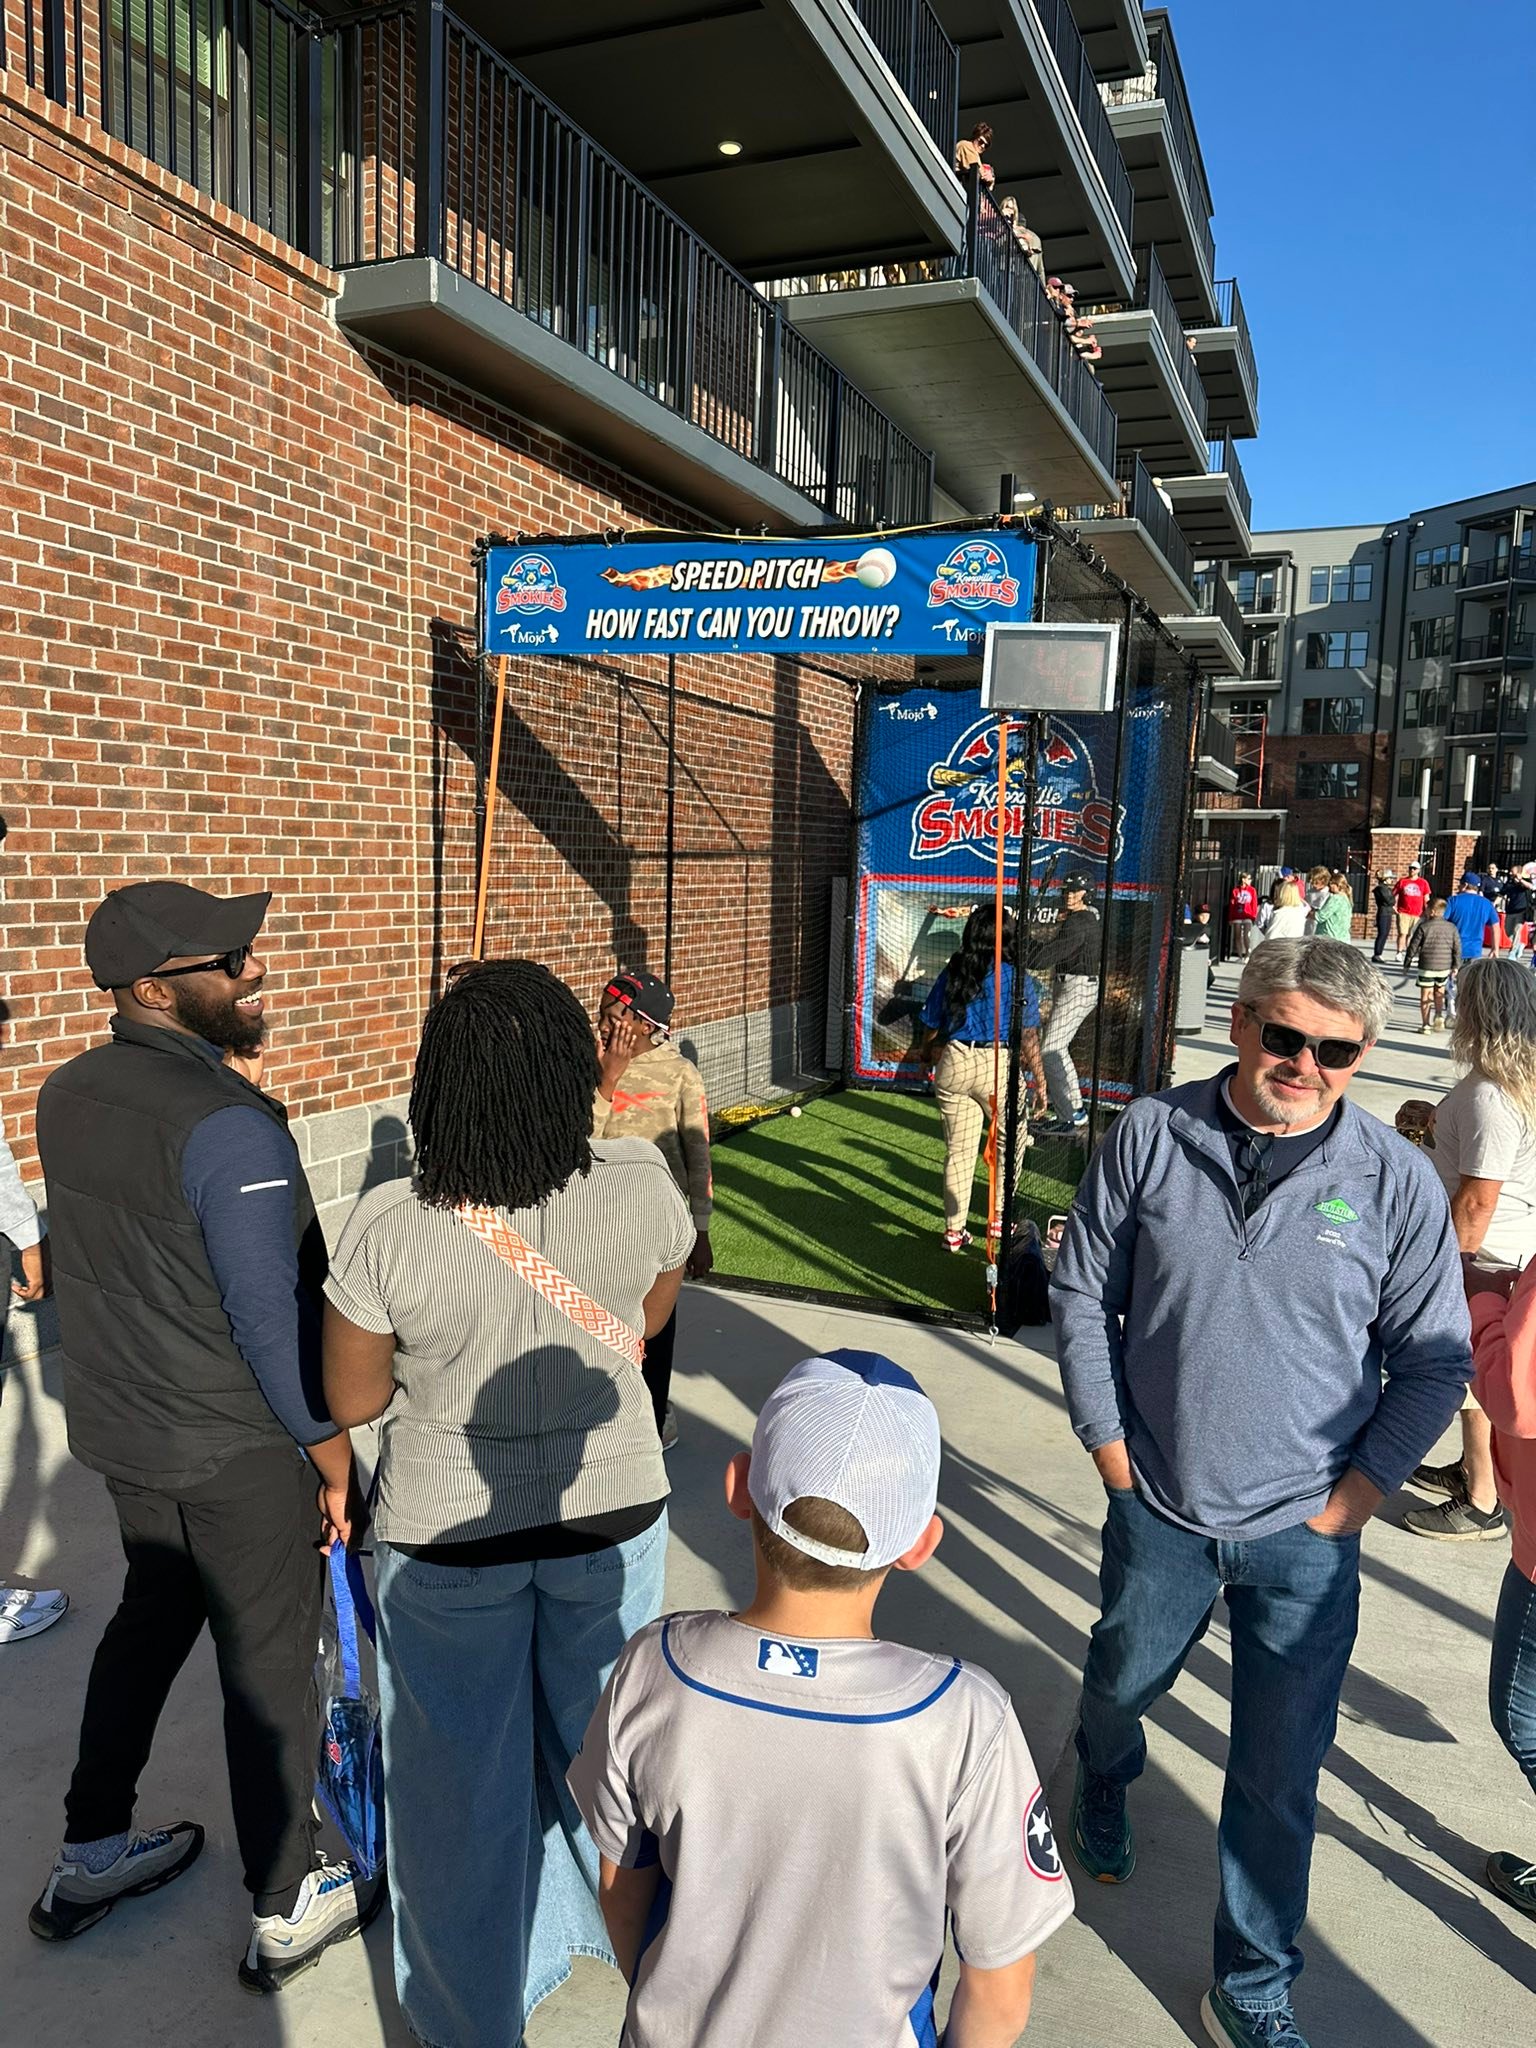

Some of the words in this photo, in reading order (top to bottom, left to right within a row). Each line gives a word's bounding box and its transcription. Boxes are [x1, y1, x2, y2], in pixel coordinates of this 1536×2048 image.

[670, 560, 745, 592] SPEED
[748, 557, 825, 590] PITCH
[498, 587, 564, 612] SMOKIES
[931, 579, 1016, 605] SMOKIES
[585, 608, 642, 640] HOW
[643, 607, 695, 640] FAST
[696, 606, 742, 639] CAN
[746, 605, 795, 638] YOU
[798, 604, 900, 638] THROW?
[518, 631, 546, 646] Mojo
[896, 707, 925, 722] Mojo
